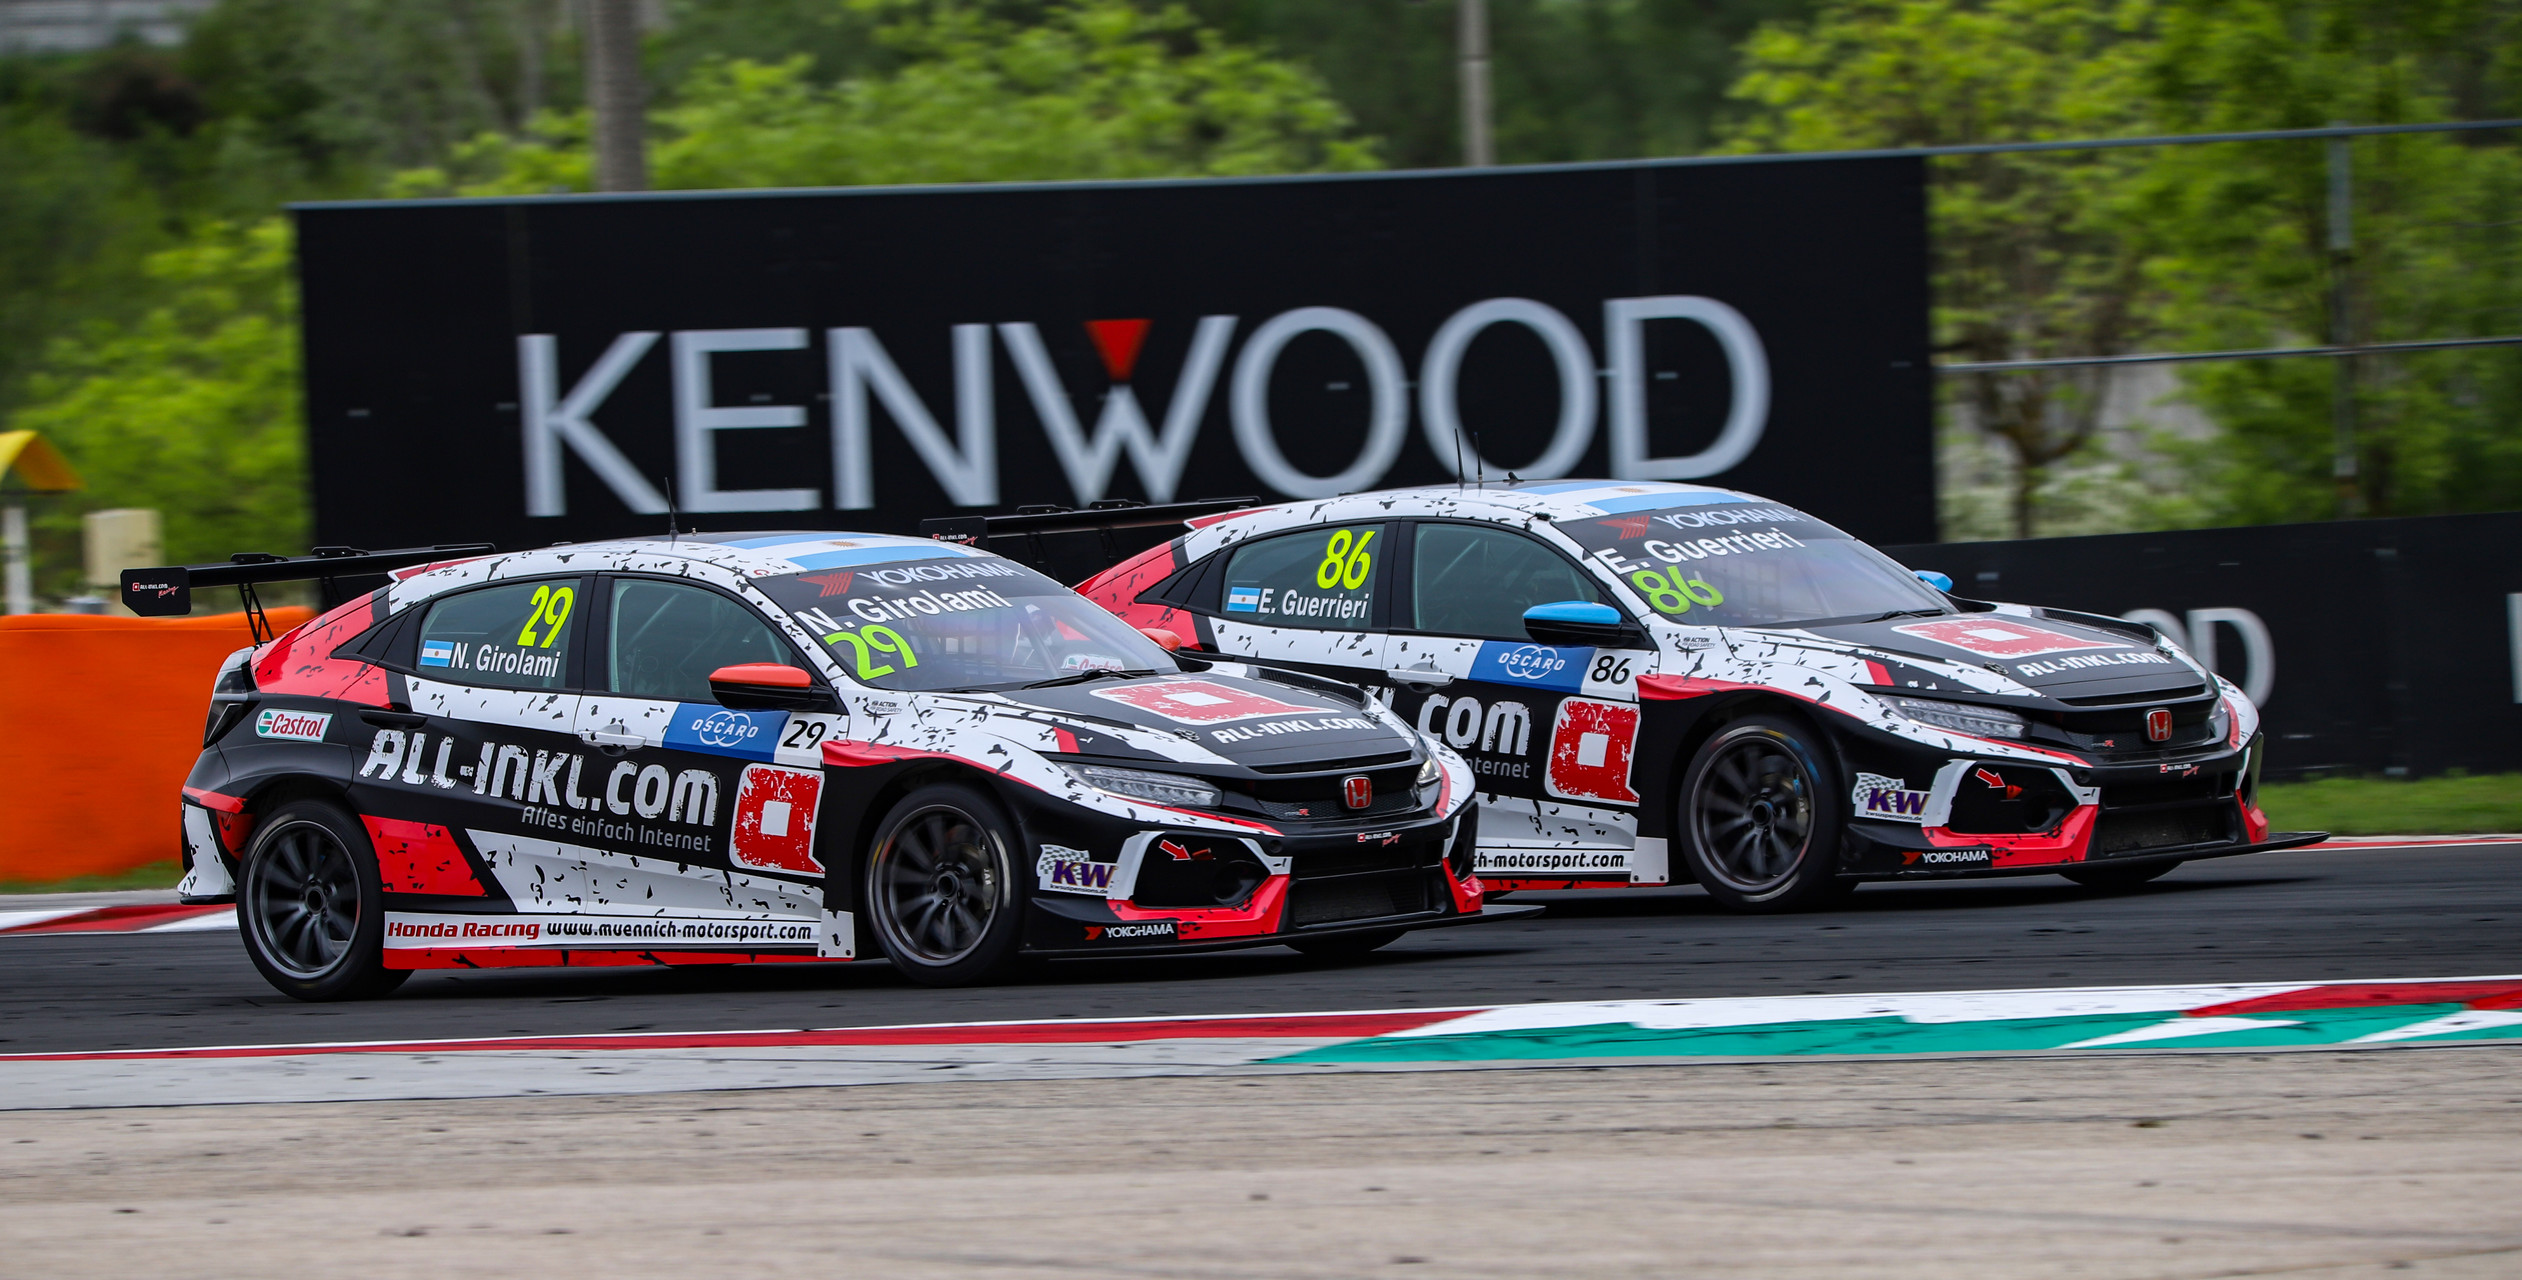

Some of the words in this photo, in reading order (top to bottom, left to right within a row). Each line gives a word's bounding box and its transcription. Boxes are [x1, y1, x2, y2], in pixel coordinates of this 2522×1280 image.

[516, 295, 1771, 517] KENWOOD
[1652, 509, 1807, 531] YOKOHAMA
[1316, 529, 1376, 590] 86
[1594, 548, 1650, 575] E.
[1645, 527, 1806, 563] Guerrieri
[856, 562, 1026, 588] YOKOHAMA
[1259, 588, 1276, 613] E.
[1282, 589, 1370, 620] Guerrieri
[1631, 566, 1724, 615] 86
[517, 585, 574, 649] 29
[794, 607, 856, 637] N.
[847, 585, 1013, 624] Girolami
[450, 642, 471, 669] N.
[476, 645, 562, 678] Girolami
[823, 624, 918, 681] 29
[1498, 652, 1566, 672] OSCARO
[1591, 655, 1633, 685] 86
[271, 712, 326, 740] Castrol
[691, 718, 760, 738] OSCARO
[782, 719, 827, 750] 29
[1467, 756, 1531, 779] nternet
[1867, 788, 1931, 816] KW
[521, 806, 568, 830] Alles
[571, 816, 635, 842] einfach
[639, 825, 712, 852] Internet
[1922, 850, 1989, 863] YOKOHAMA
[1052, 860, 1117, 889] KW
[388, 922, 458, 937] Honda
[462, 922, 541, 940] Racing
[547, 920, 812, 942] www.muennich-motorsport.com
[1105, 924, 1175, 938] YOKOHAMA
